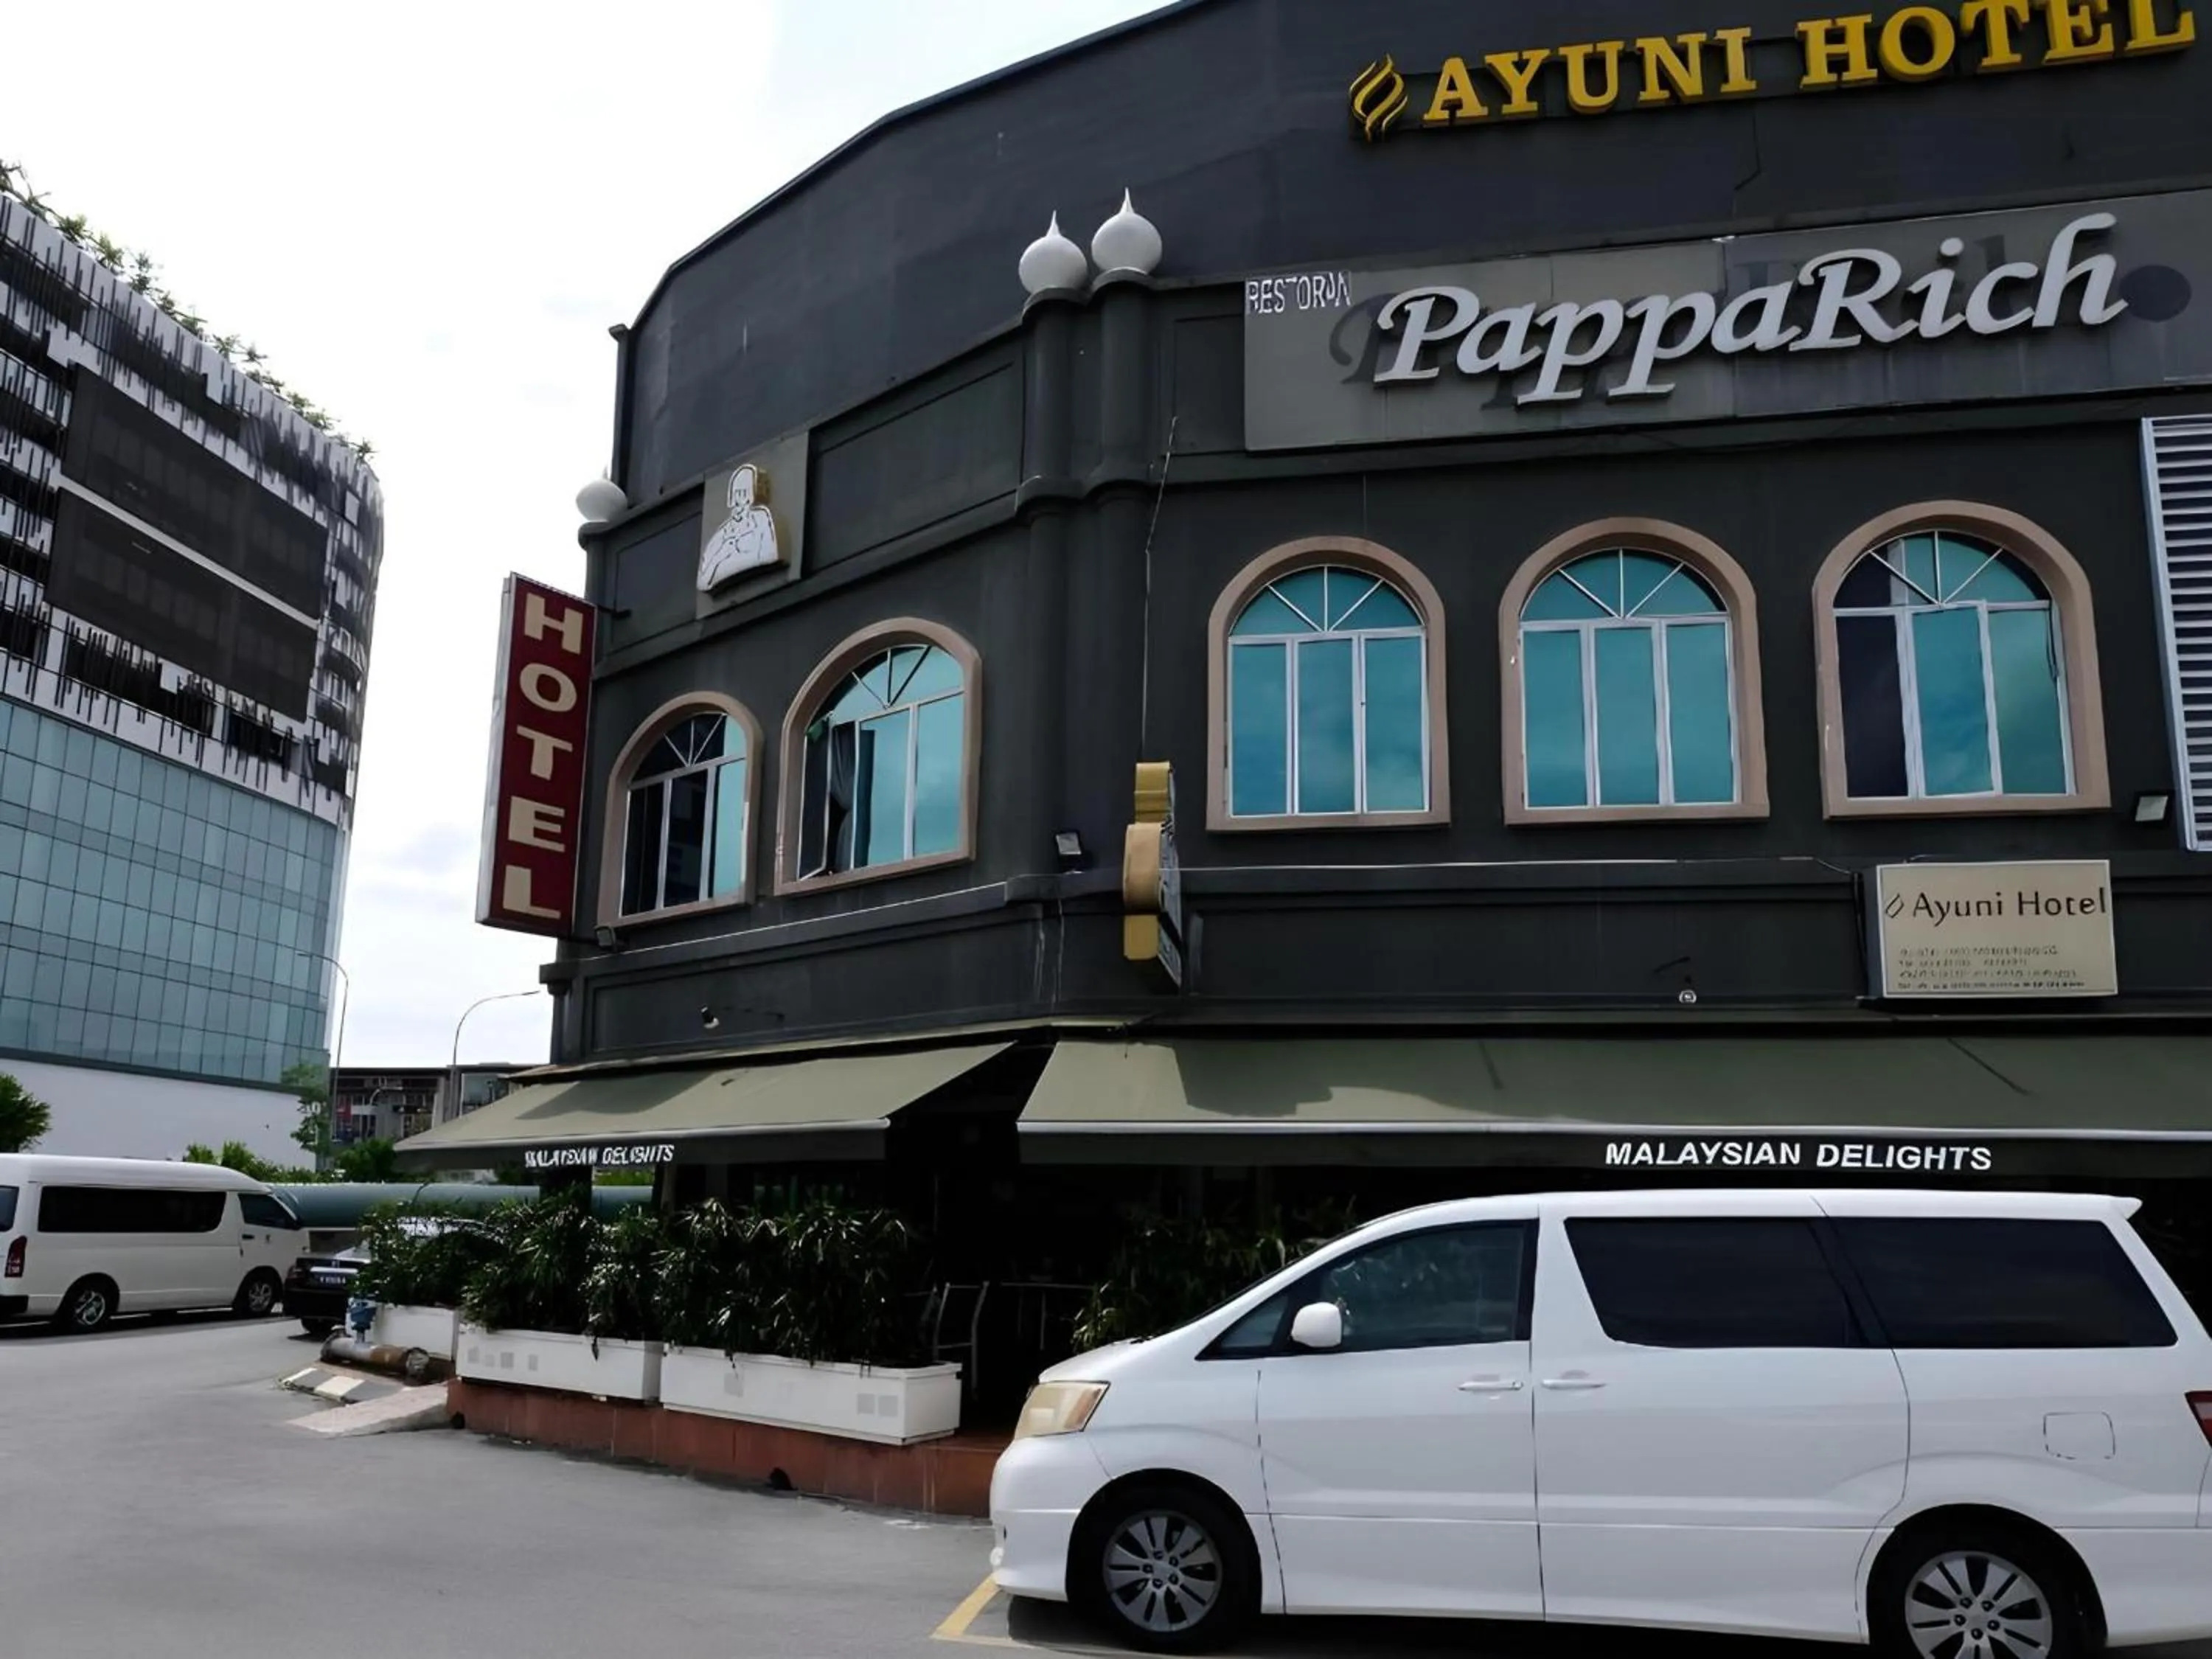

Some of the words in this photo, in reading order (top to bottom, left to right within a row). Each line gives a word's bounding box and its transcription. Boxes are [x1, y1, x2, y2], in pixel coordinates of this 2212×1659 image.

[1422, 26, 1758, 125] AYUNI
[1795, 0, 2196, 89] HOTEL
[1374, 212, 2129, 407] PappaRich
[502, 592, 584, 920] HOTEL
[1913, 891, 2003, 927] Ayuni
[2017, 886, 2107, 917] Hotel
[1604, 1141, 1801, 1165] MALAYSIAN
[1816, 1144, 1992, 1170] DELIGHTS
